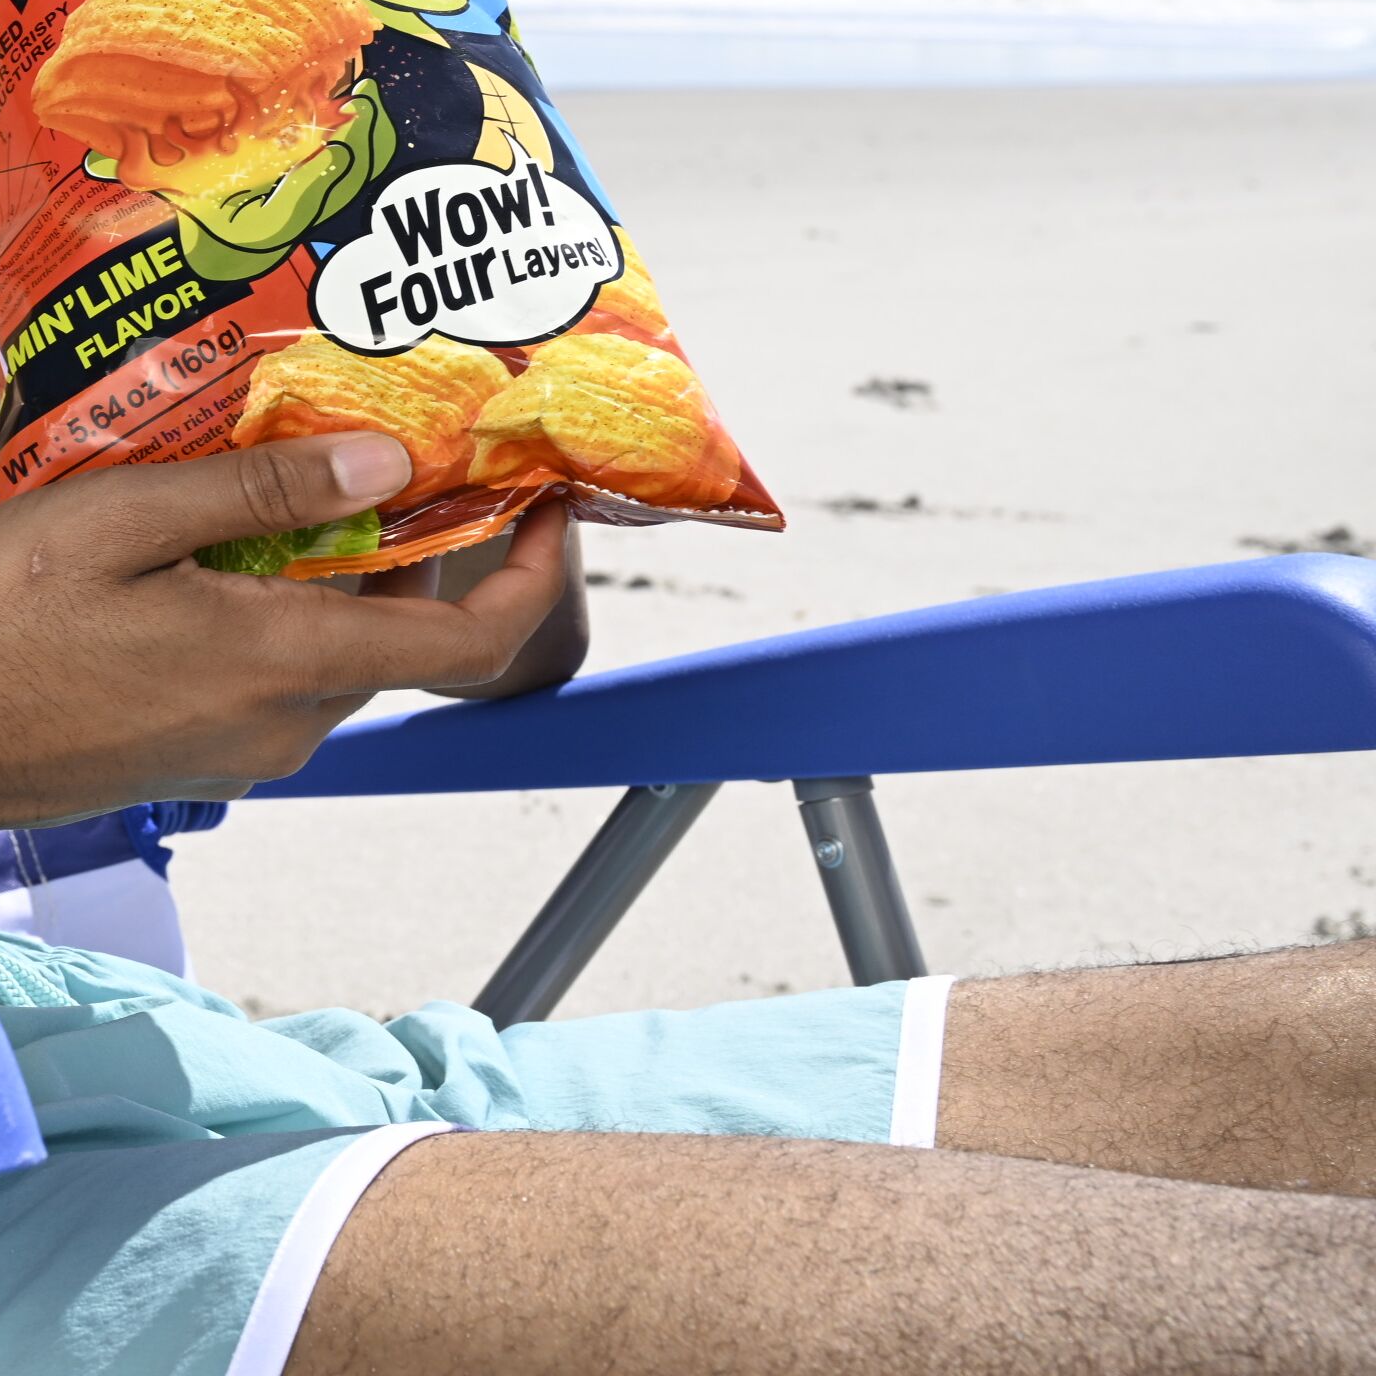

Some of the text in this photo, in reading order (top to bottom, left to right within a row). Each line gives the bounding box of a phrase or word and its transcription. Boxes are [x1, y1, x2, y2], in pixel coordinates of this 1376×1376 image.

[10, 1, 68, 63] CRISPY
[53, 191, 70, 212] rich
[59, 199, 86, 229] several
[112, 194, 156, 224] alluring
[381, 163, 555, 267] Wow!
[360, 237, 612, 346] Four Layers!
[75, 280, 207, 369] FLAVOR
[66, 395, 127, 444] 5.64
[126, 381, 161, 409] oz
[163, 426, 182, 449] by
[183, 406, 213, 432] rich
[181, 426, 224, 456] create
